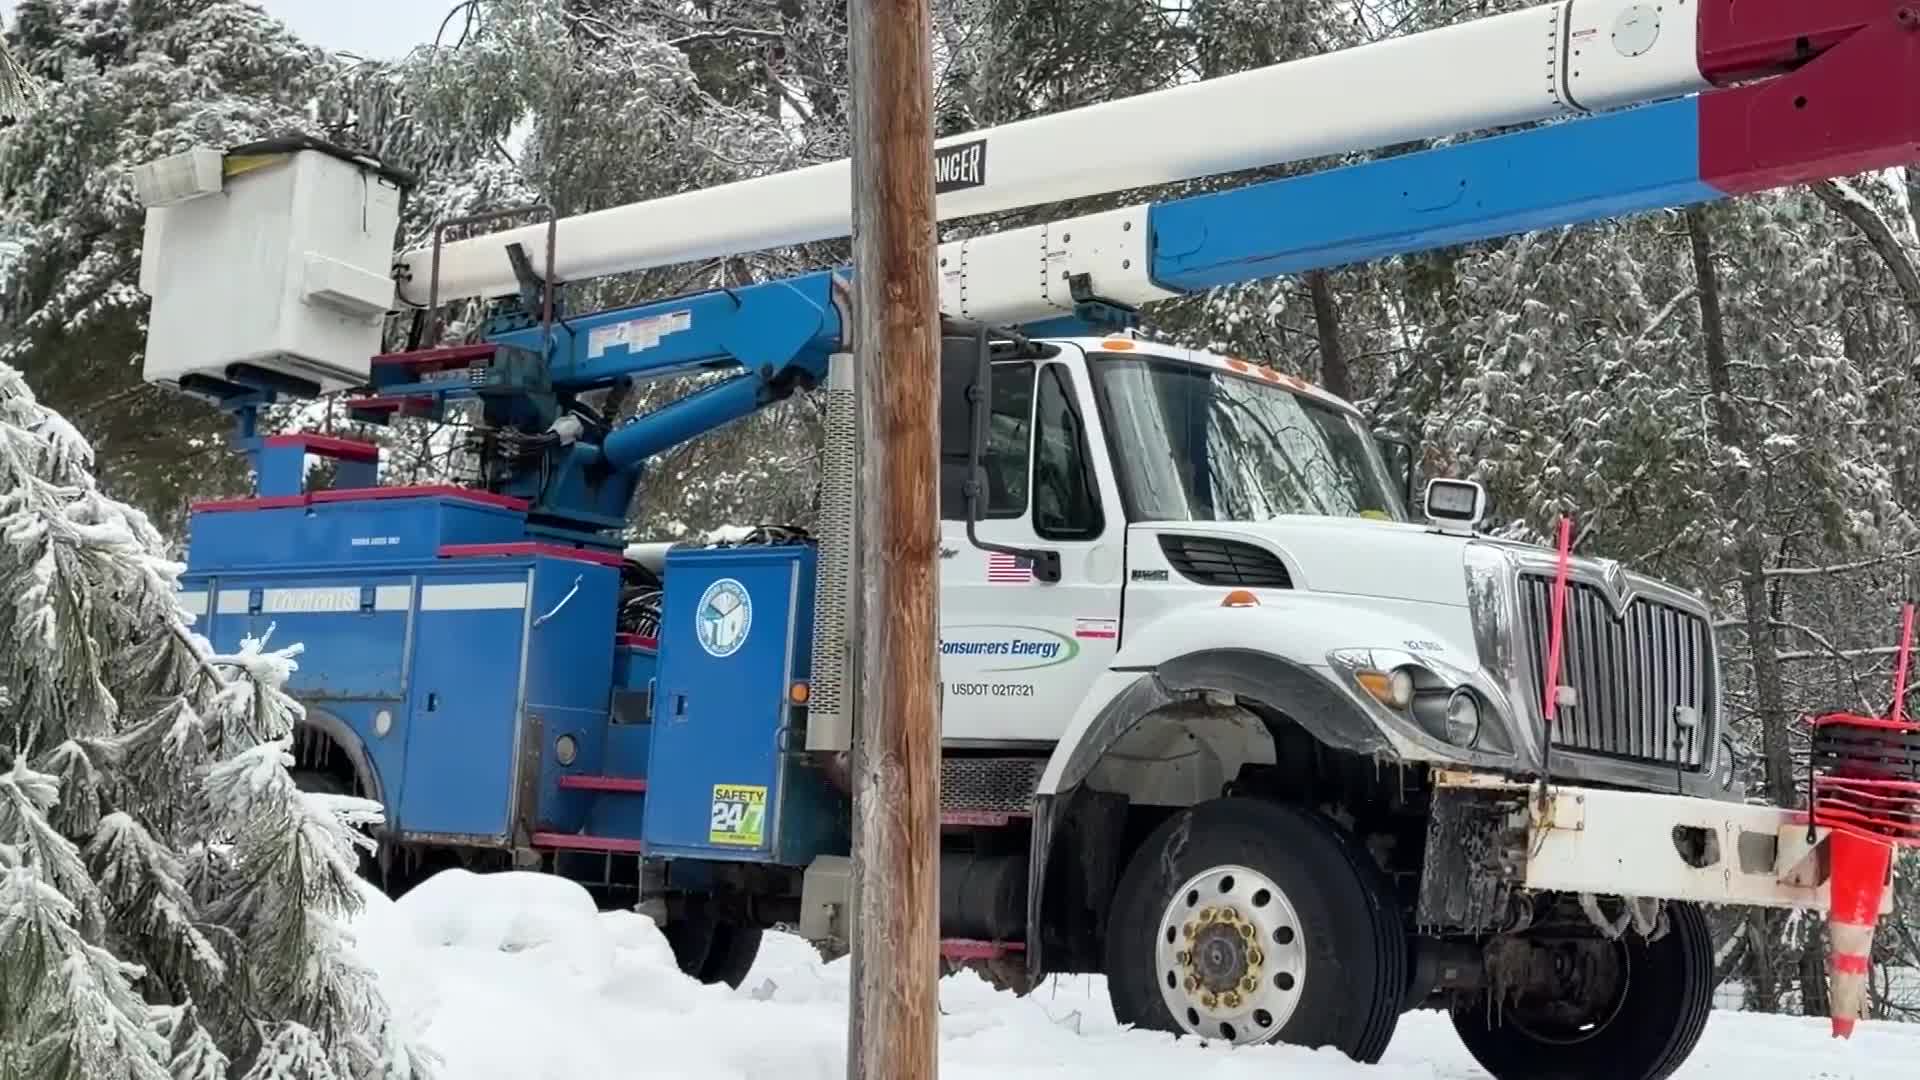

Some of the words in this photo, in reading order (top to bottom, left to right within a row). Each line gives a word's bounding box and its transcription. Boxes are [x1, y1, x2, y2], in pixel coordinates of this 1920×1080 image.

[1011, 639, 1061, 658] Energy
[951, 683, 989, 696] USDOT
[991, 684, 1035, 697] 0217321
[715, 788, 764, 801] SAFETY
